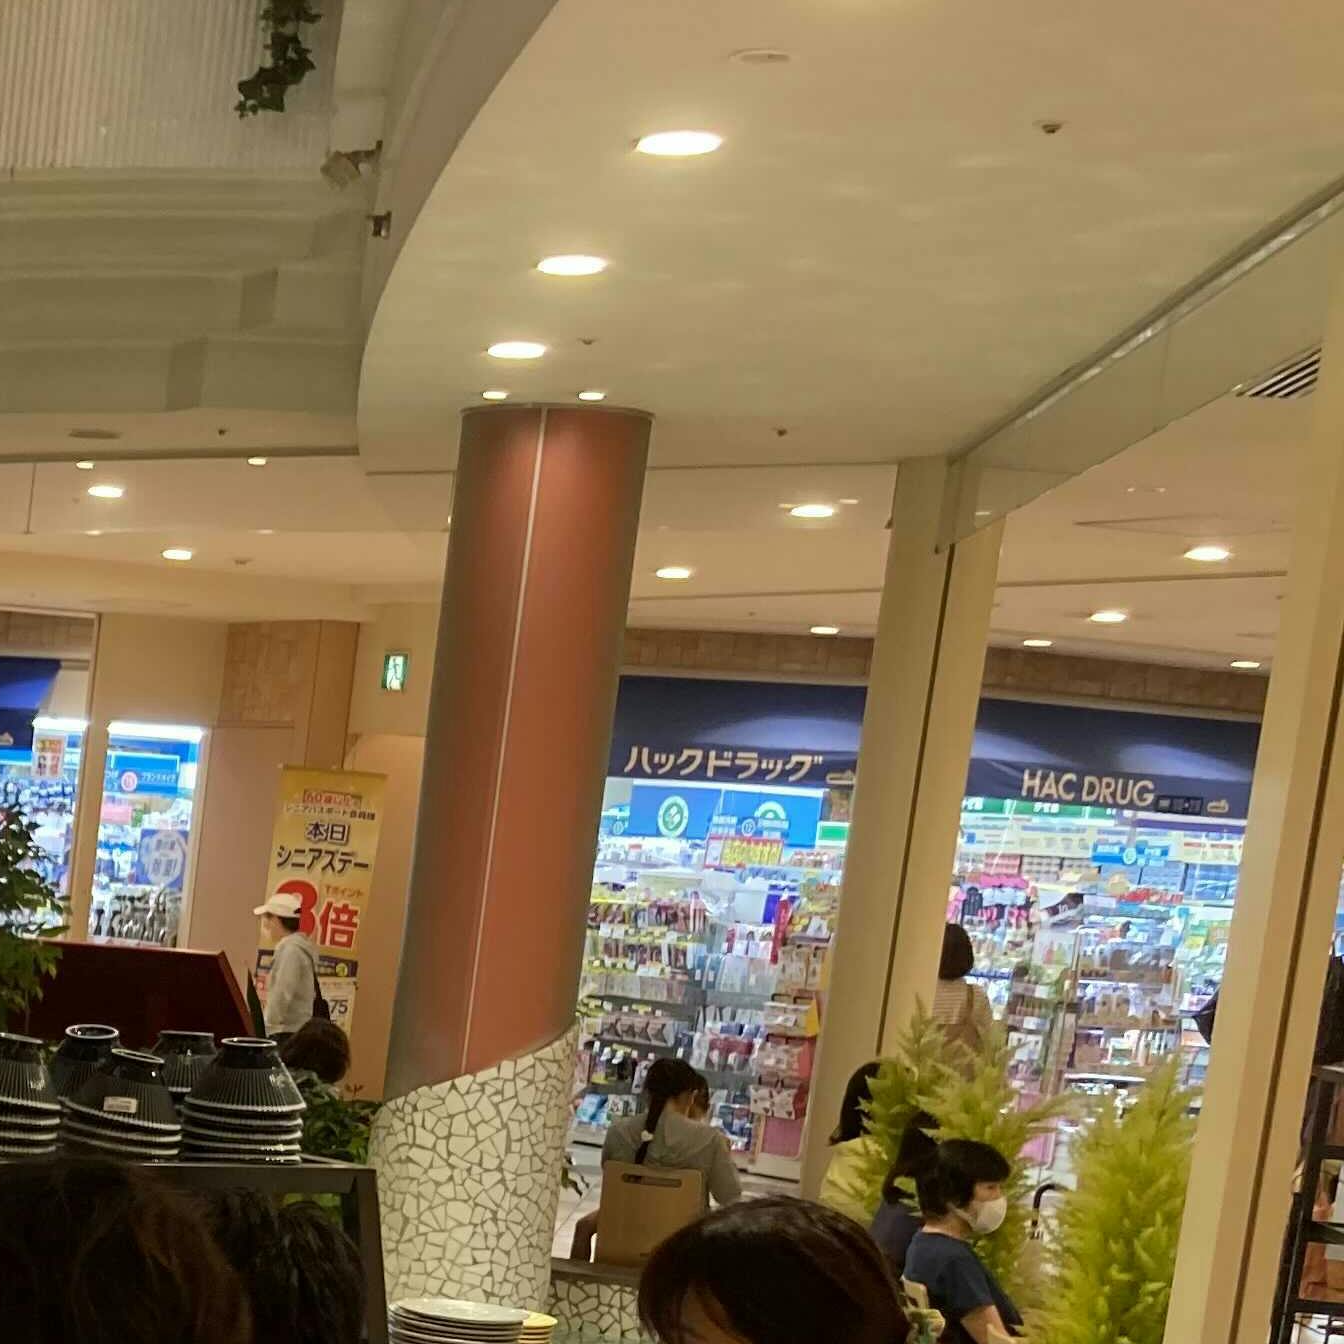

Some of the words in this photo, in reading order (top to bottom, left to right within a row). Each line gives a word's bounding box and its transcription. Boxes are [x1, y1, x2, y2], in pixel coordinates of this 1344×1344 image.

[624, 746, 823, 782] ハックドラッグ
[1021, 769, 1076, 801] HAC
[1081, 776, 1155, 806] DRUG
[306, 821, 349, 844] 本日
